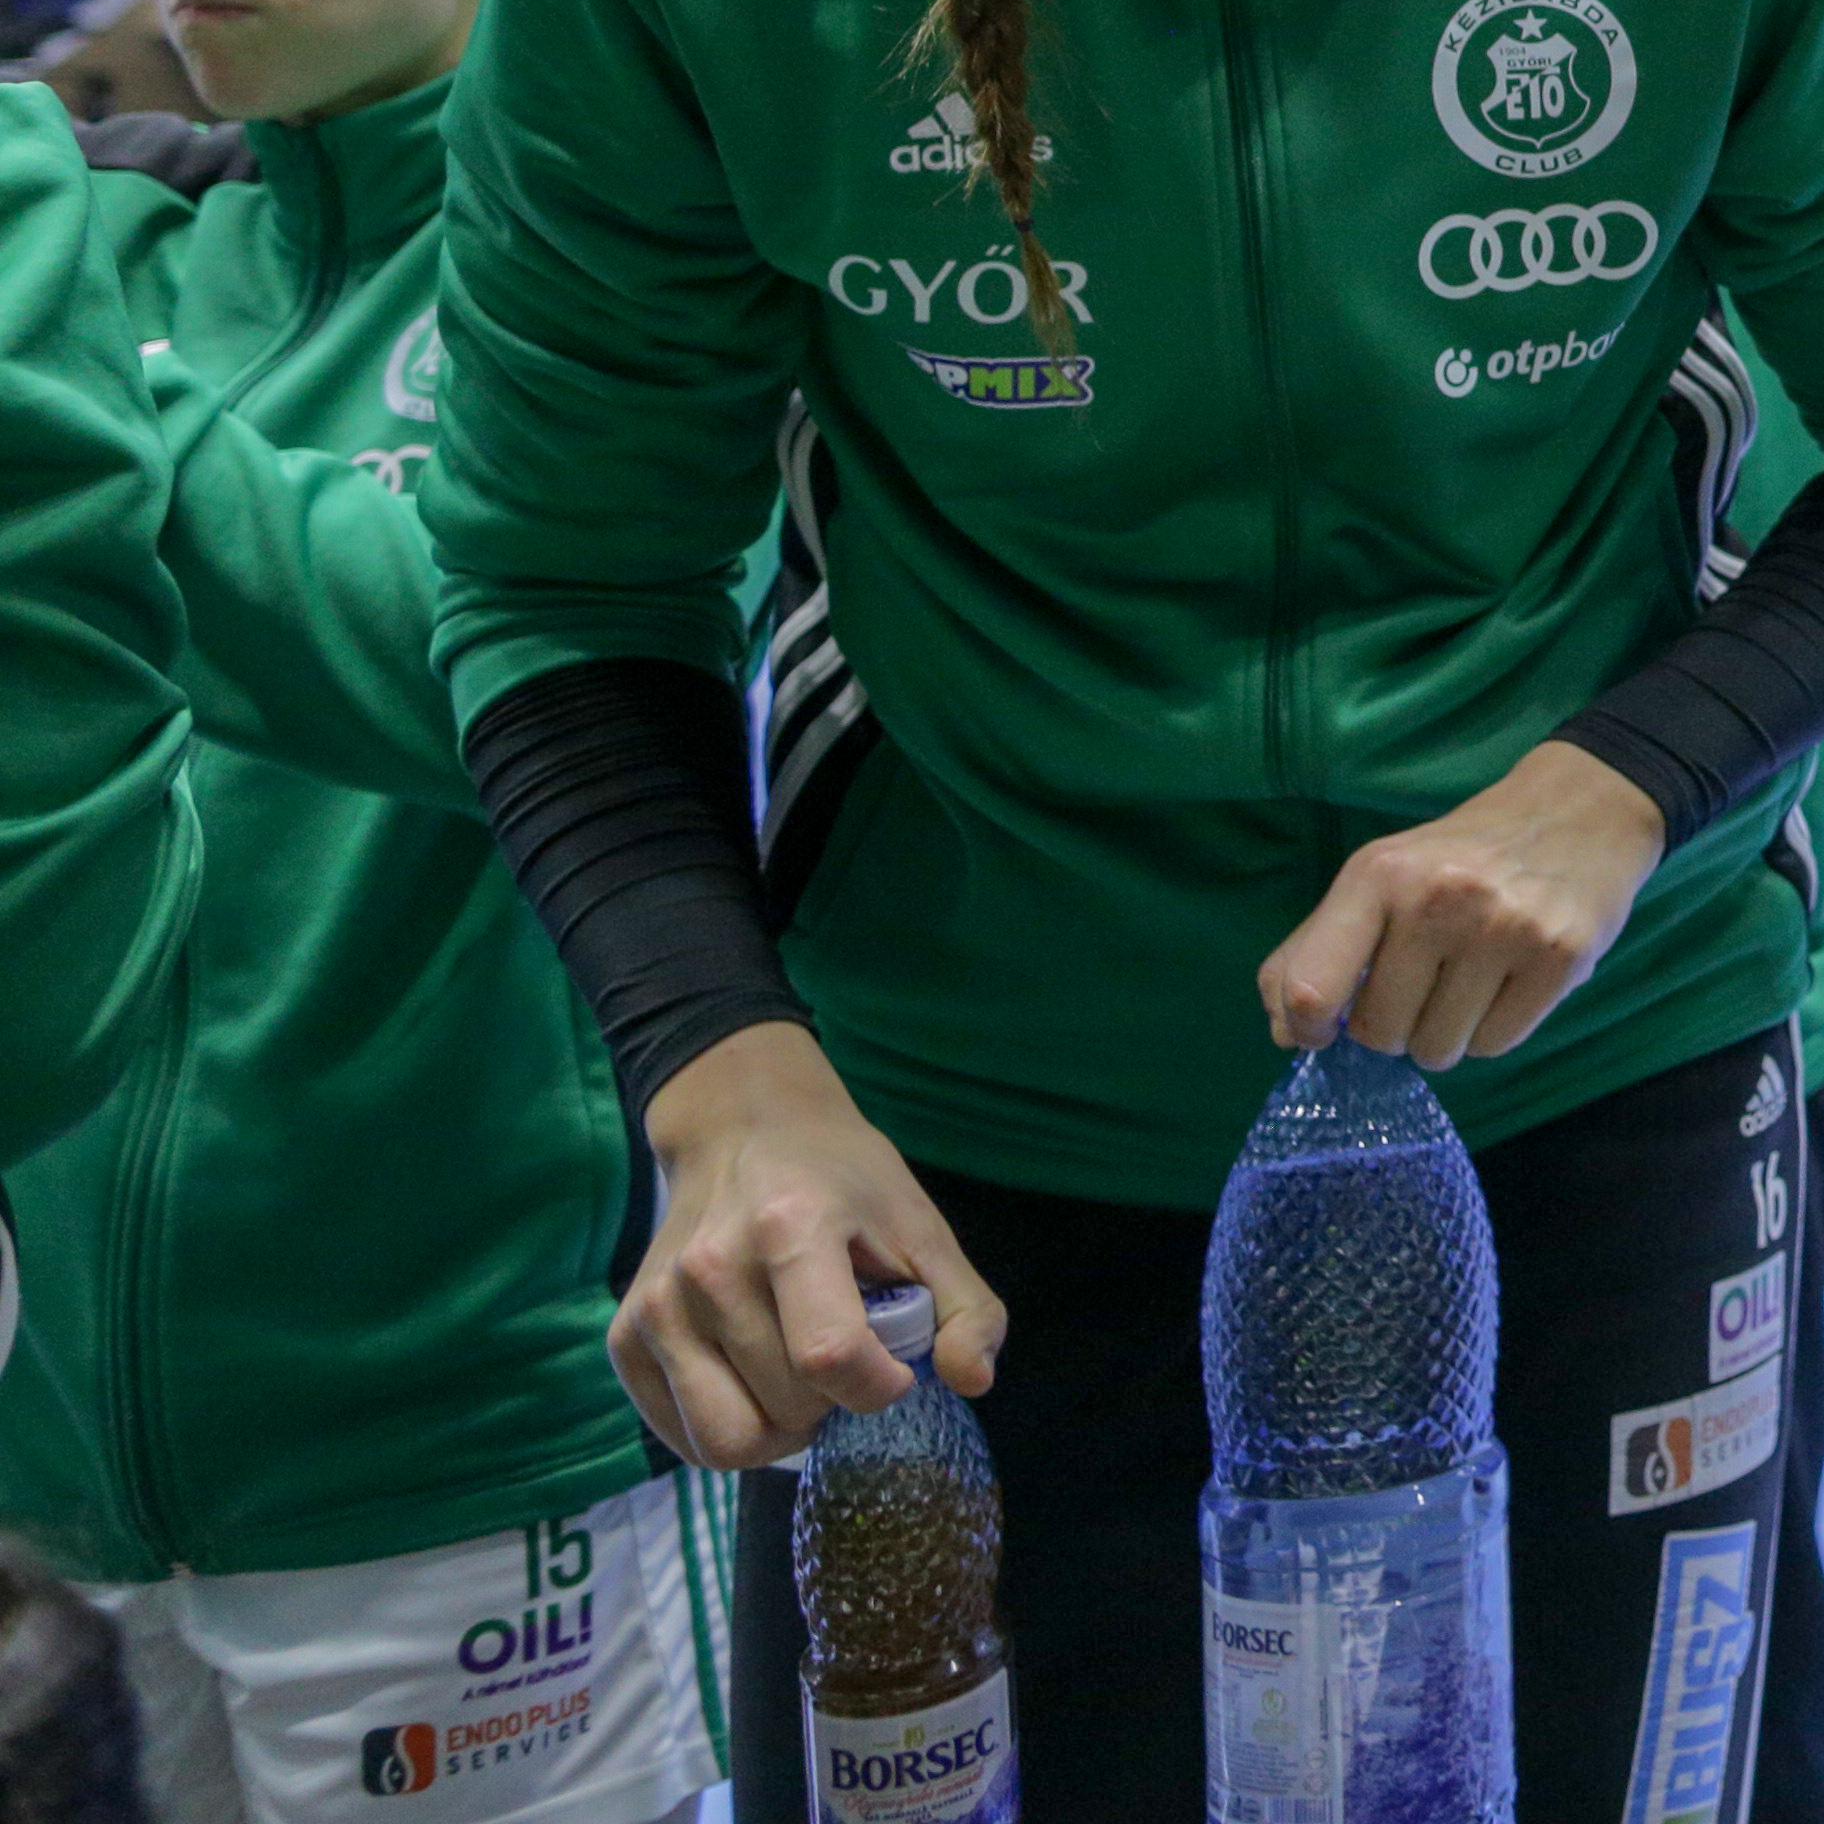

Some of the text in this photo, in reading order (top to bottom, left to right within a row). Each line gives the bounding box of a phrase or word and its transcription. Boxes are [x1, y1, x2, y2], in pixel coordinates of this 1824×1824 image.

[889, 134, 1054, 173] adis
[1495, 148, 1583, 173] CLUB
[828, 245, 1095, 325] GYŐR
[1750, 1150, 1788, 1249] 16
[526, 1517, 593, 1599] 15
[458, 1592, 593, 1674] OIL!
[1213, 1612, 1295, 1656] BORSEC
[447, 1688, 592, 1753] ENDO PLUS
[447, 1713, 592, 1776] SERVICE
[829, 1718, 997, 1791] BORSEC
